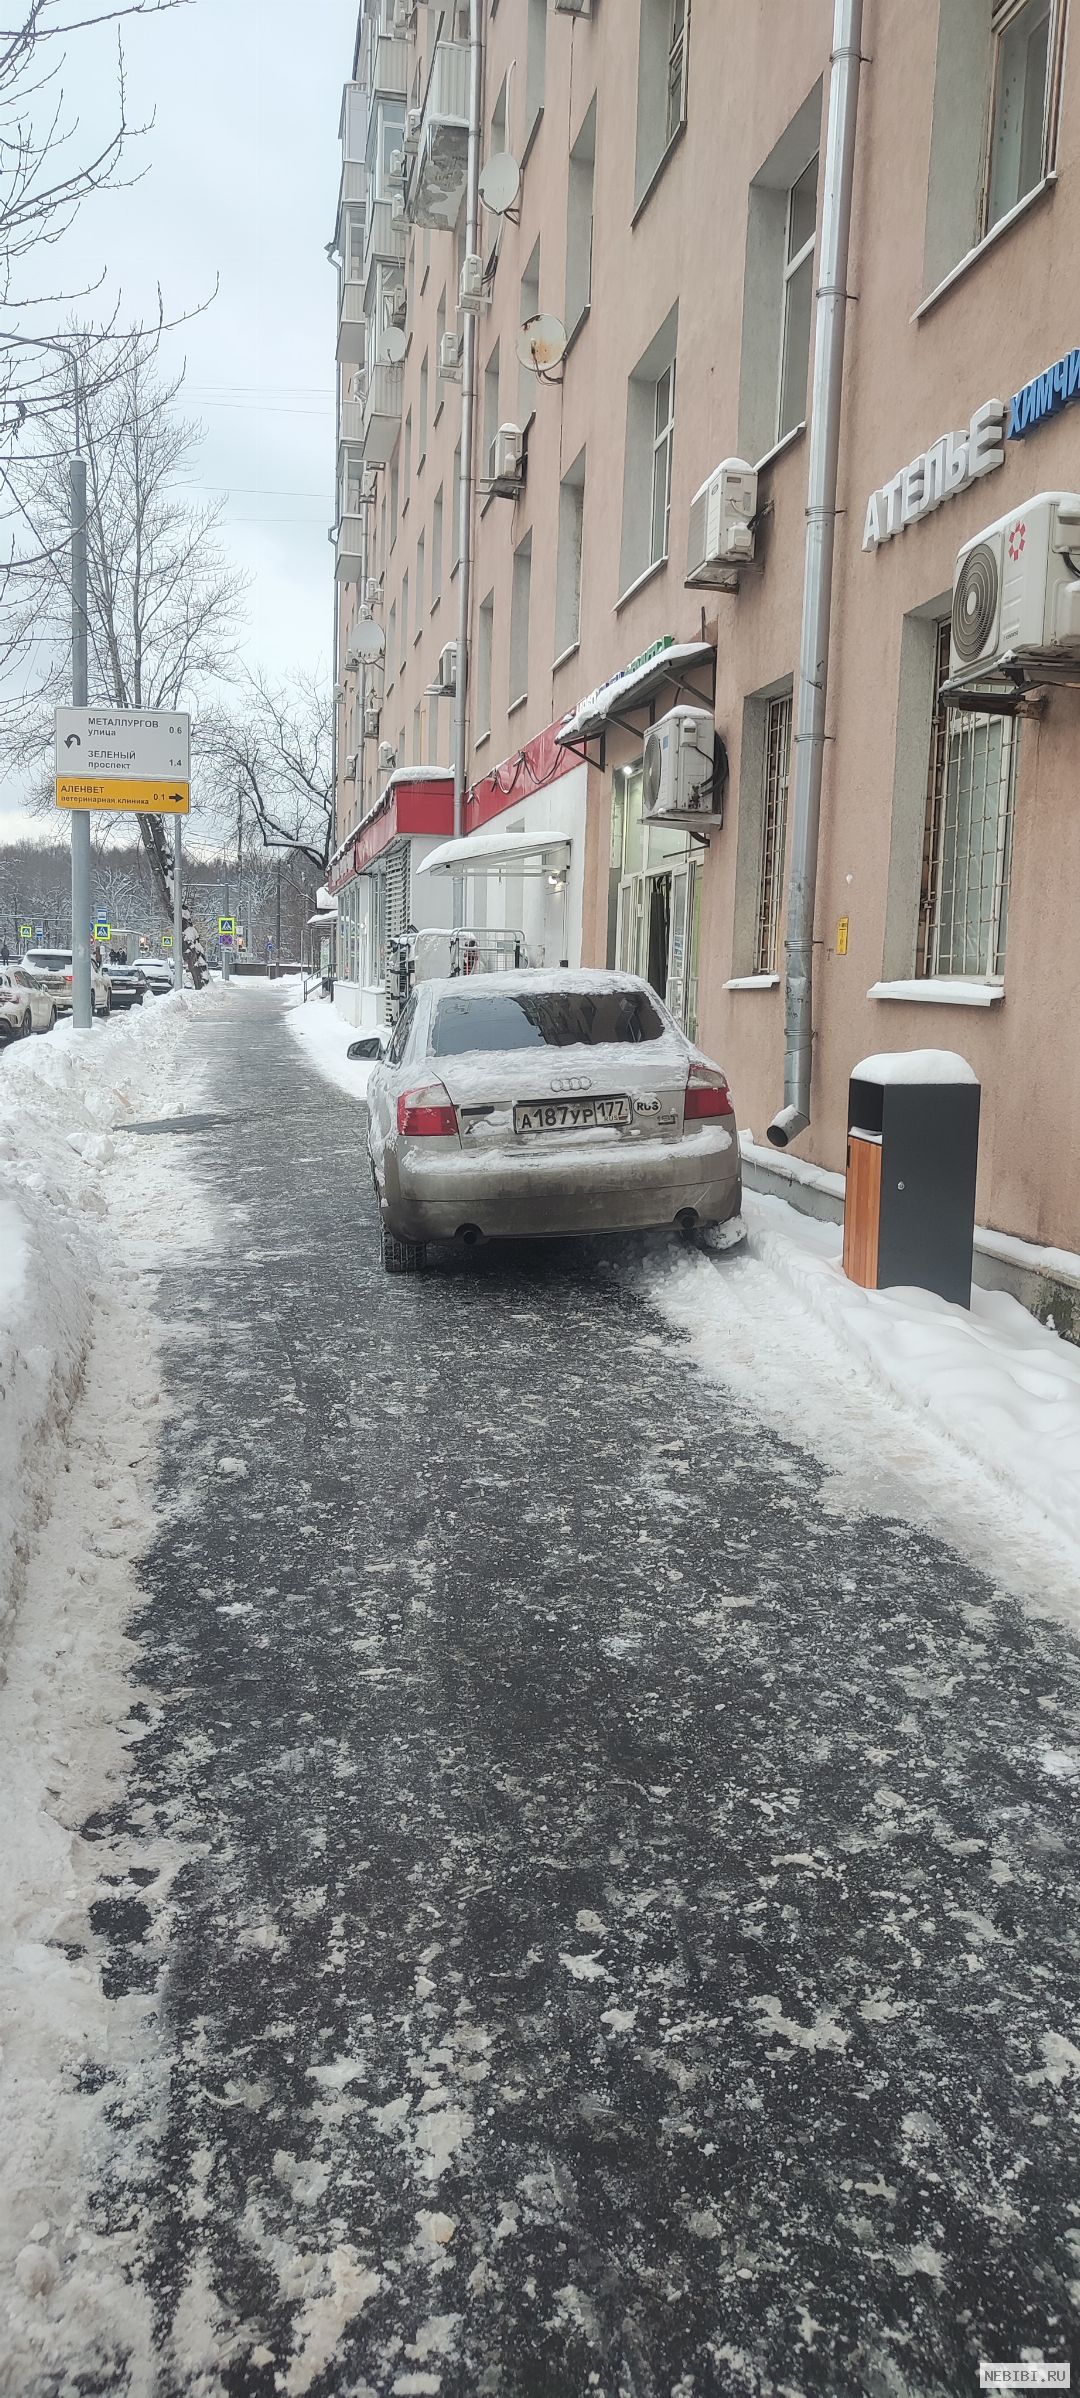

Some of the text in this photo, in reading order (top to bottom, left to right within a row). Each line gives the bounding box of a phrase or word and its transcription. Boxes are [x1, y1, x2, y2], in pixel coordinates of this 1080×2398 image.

[861, 398, 1005, 553] АТЕЛЬЕ
[87, 717, 159, 728] МЕТАЛЛУРГОВ
[87, 728, 116, 737] улица
[87, 749, 136, 760] ЗЕЛЕНЫЙ
[87, 761, 132, 770] проспект
[168, 759, 182, 767] 1.4
[60, 785, 105, 794] АЛЕНВЕТ
[61, 796, 116, 804] ветеринарная
[637, 1101, 659, 1111] RUS
[521, 1101, 624, 1129] А187УР 177
